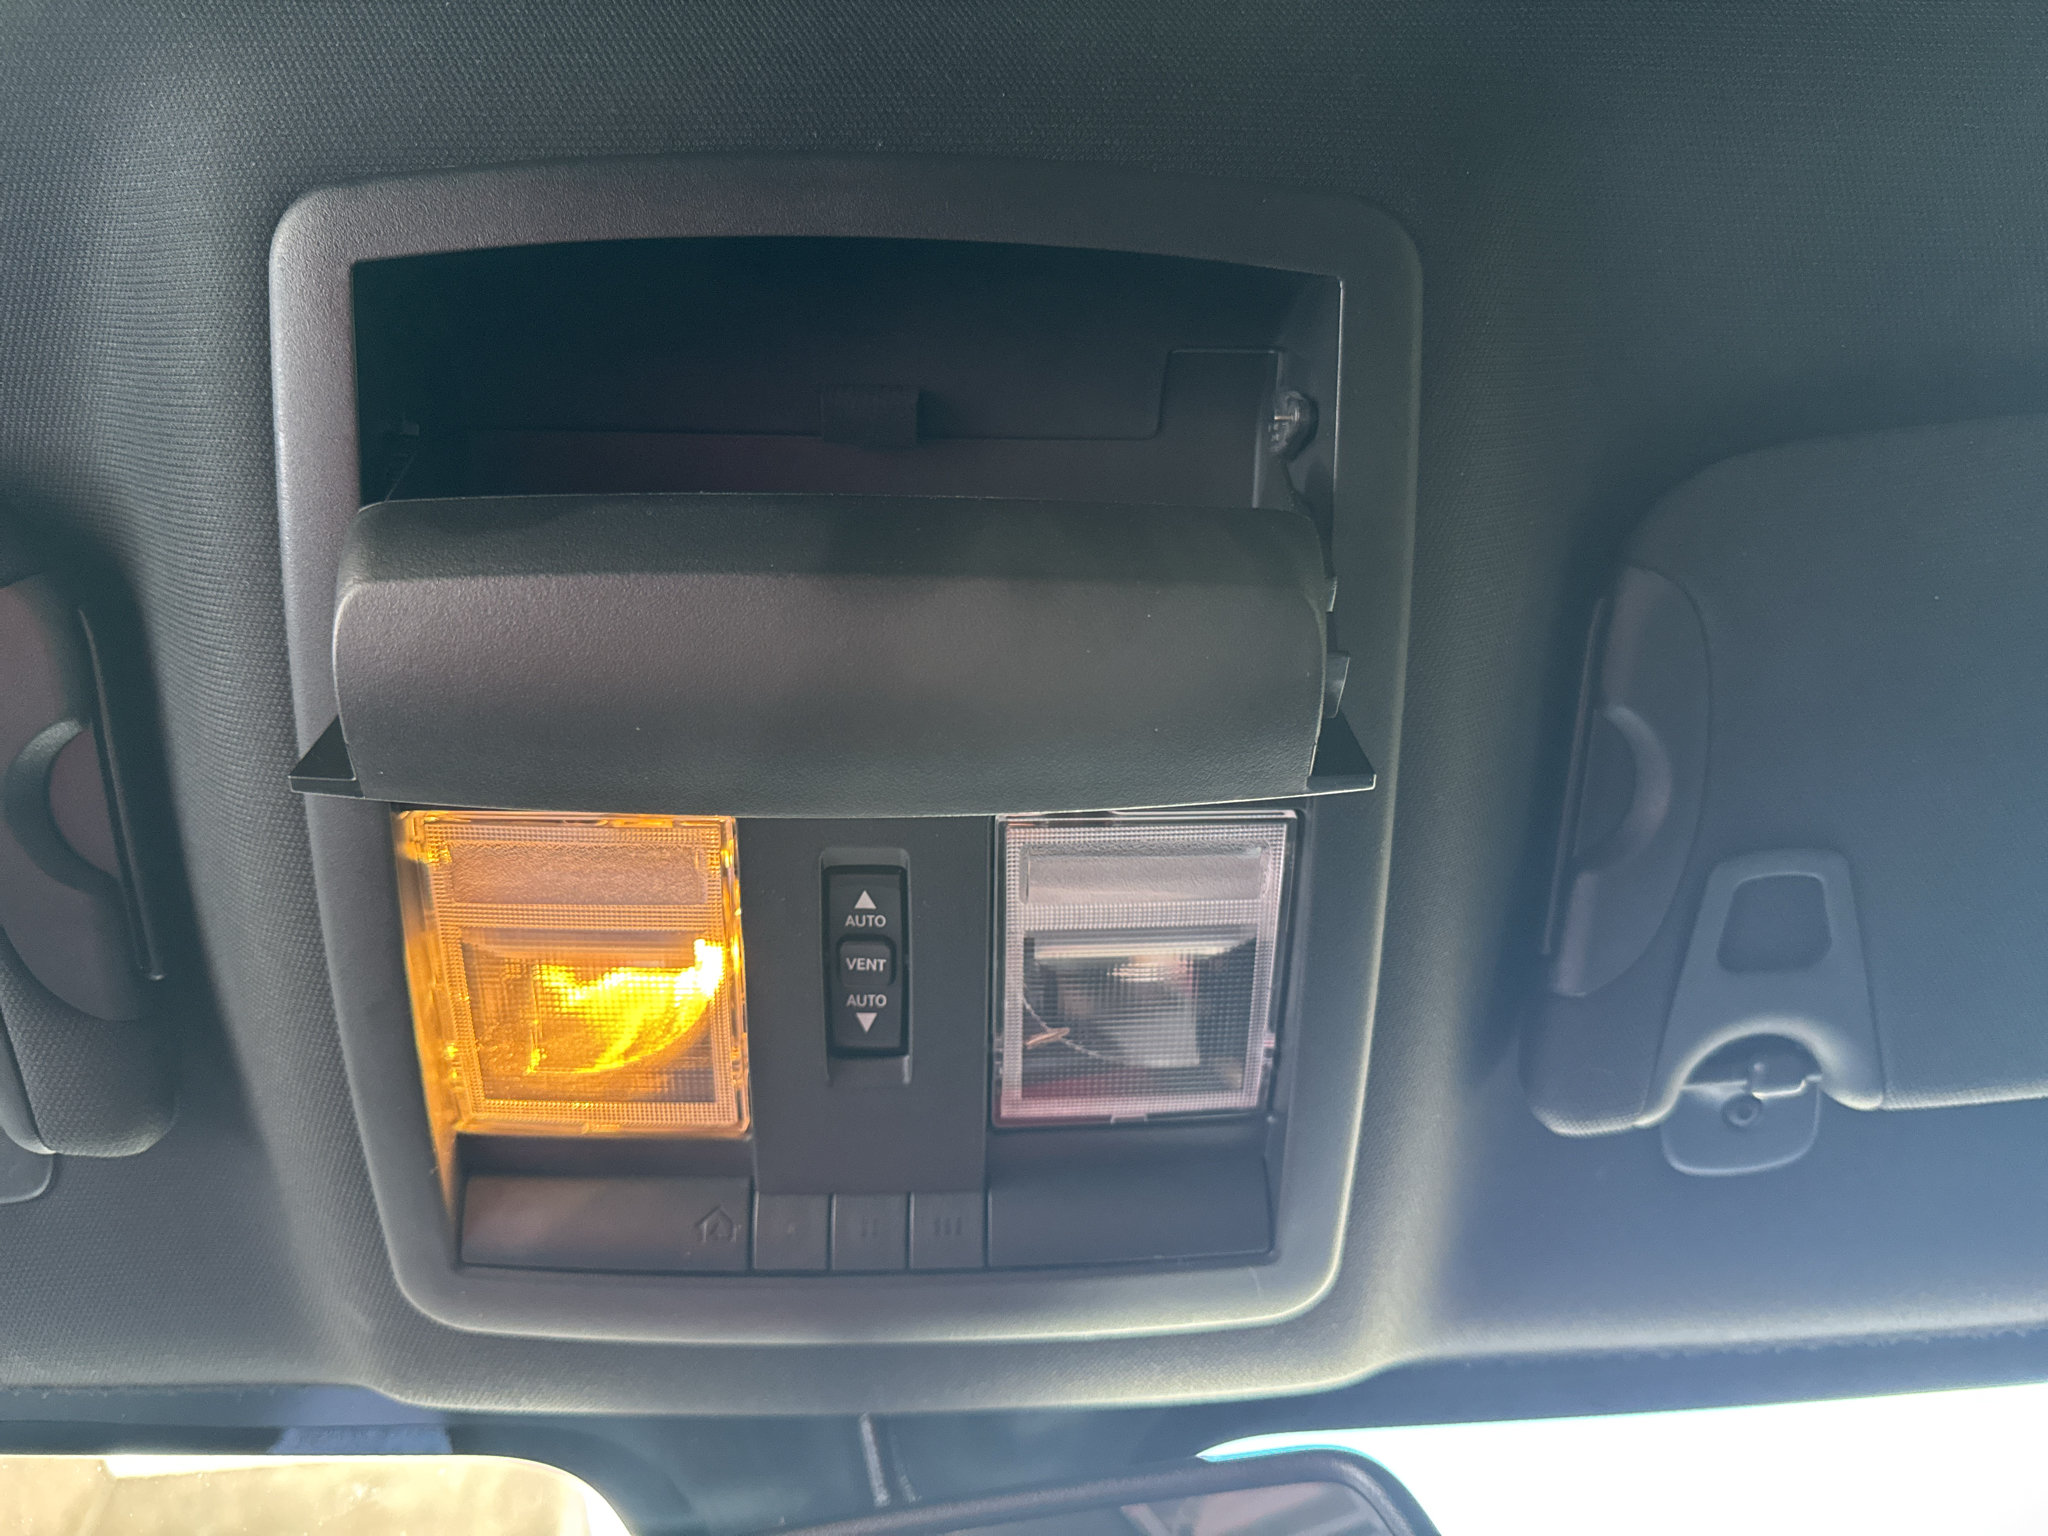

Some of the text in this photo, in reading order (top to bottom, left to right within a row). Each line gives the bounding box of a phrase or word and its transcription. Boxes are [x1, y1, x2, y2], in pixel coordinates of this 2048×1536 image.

[845, 914, 887, 928] AUTO
[846, 957, 887, 972] VENT
[846, 994, 887, 1008] AUTO
